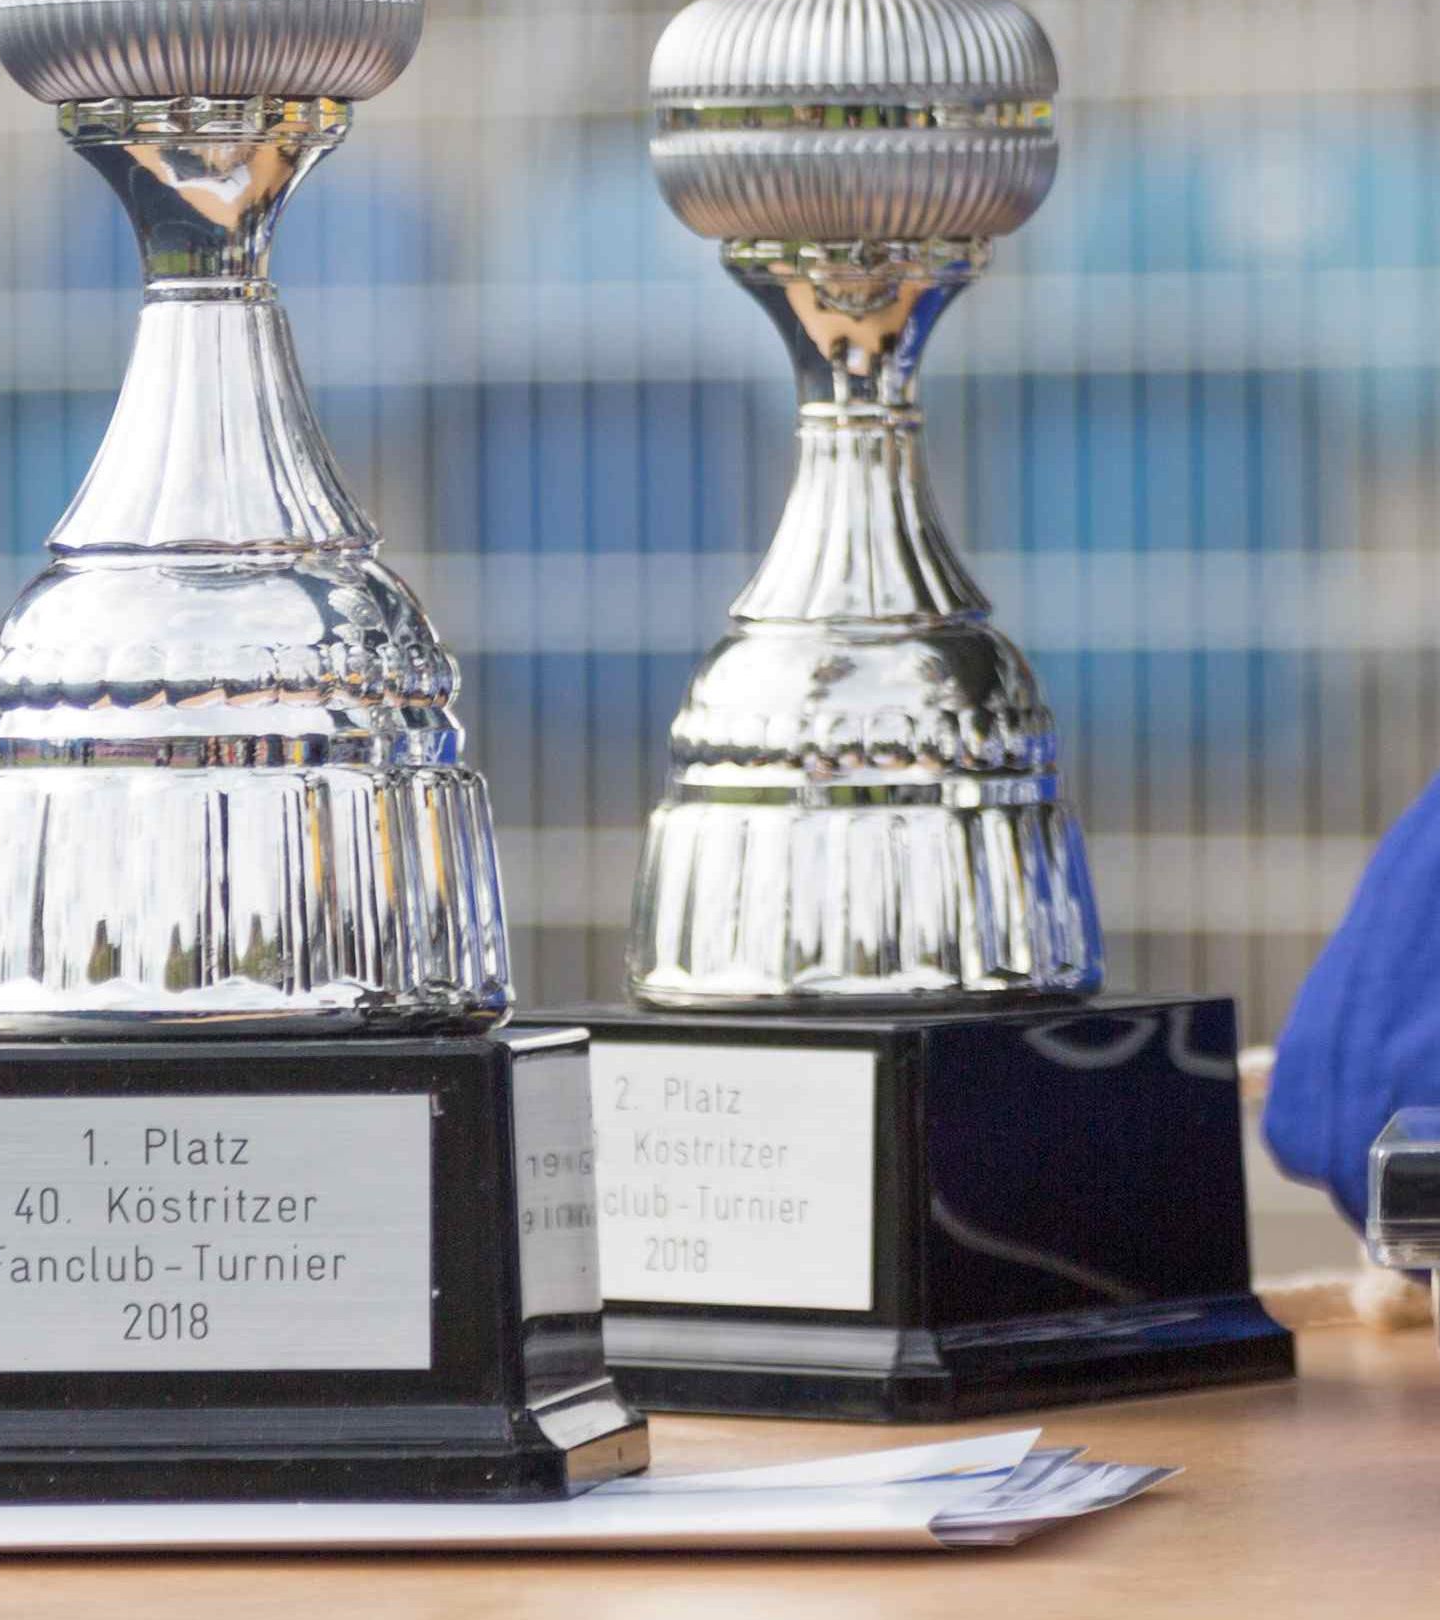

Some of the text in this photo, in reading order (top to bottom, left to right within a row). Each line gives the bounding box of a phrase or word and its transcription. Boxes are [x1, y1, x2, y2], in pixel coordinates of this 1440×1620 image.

[615, 1075, 742, 1116] 2. Platz
[82, 1128, 249, 1166] 1. Platz
[14, 1185, 318, 1225] 40. Köstritzer
[603, 1184, 809, 1224] club-Turnier
[644, 1235, 709, 1274] 2018
[122, 1302, 209, 1341] 2018
